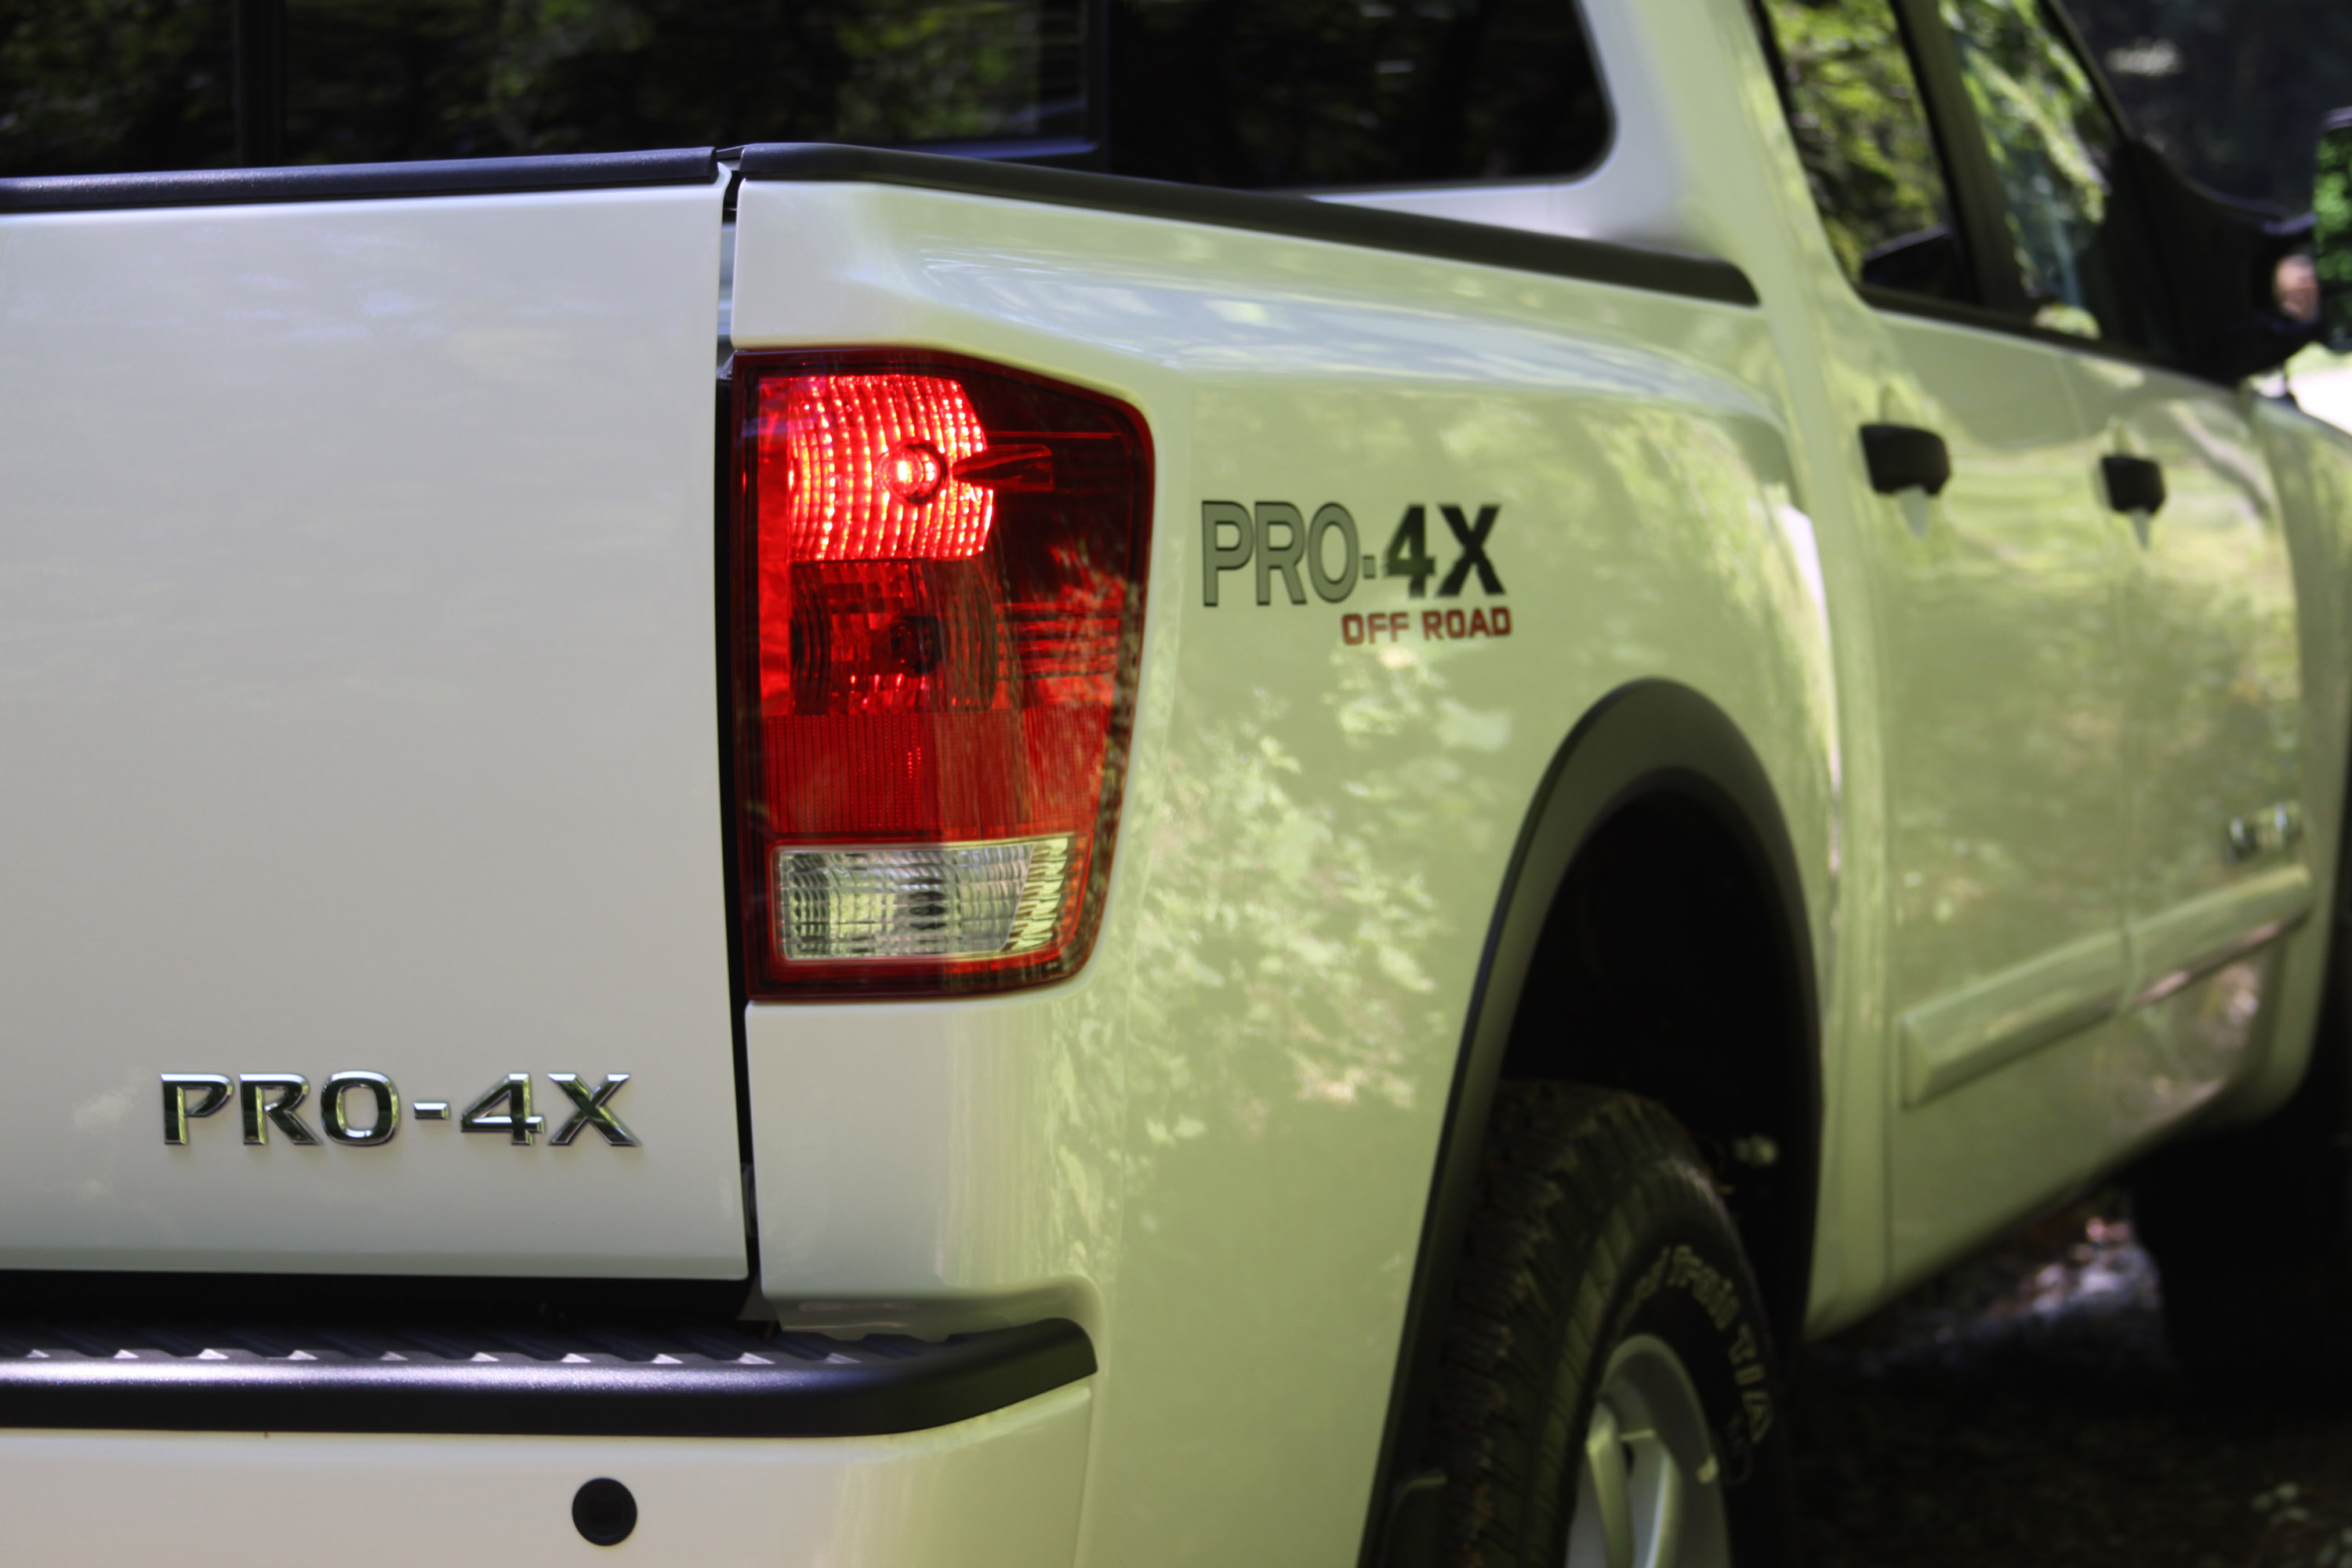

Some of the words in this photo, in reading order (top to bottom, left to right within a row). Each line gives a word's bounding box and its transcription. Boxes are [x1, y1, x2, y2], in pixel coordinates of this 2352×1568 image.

[1201, 500, 1505, 607] PRO-4X
[1341, 612, 1410, 644] OFF
[1421, 607, 1512, 641] ROAD
[160, 1069, 641, 1146] PRO-4X
